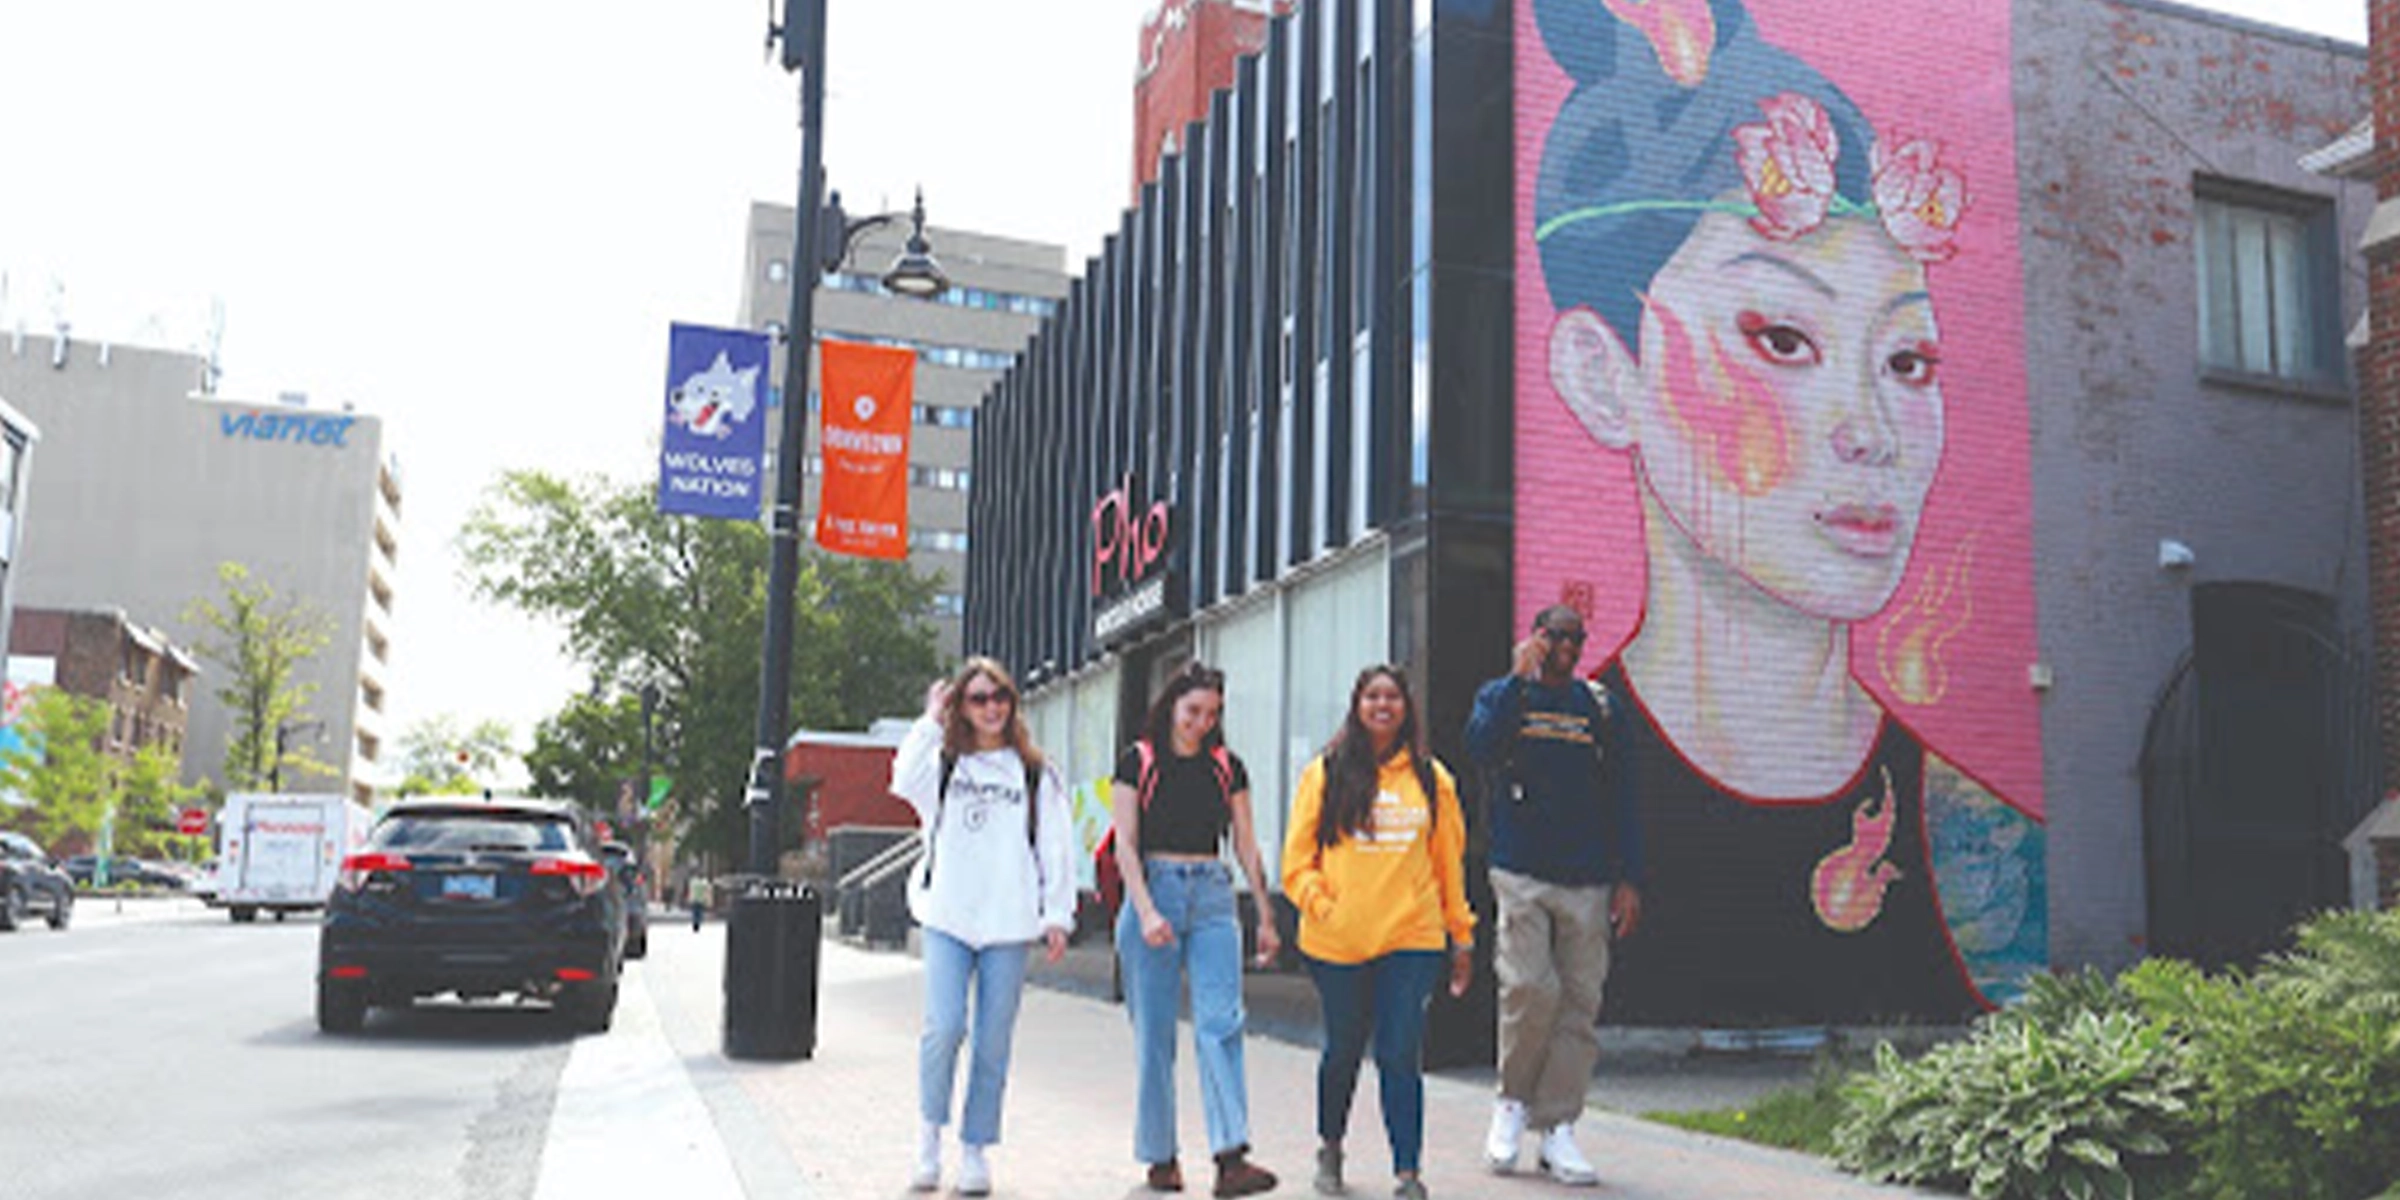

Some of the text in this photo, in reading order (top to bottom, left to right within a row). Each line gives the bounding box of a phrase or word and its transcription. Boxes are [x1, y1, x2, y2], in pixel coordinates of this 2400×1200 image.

[220, 409, 355, 448] vianet
[665, 451, 756, 476] WOLVES
[669, 475, 750, 498] NATION
[1090, 471, 1169, 597] Pho
